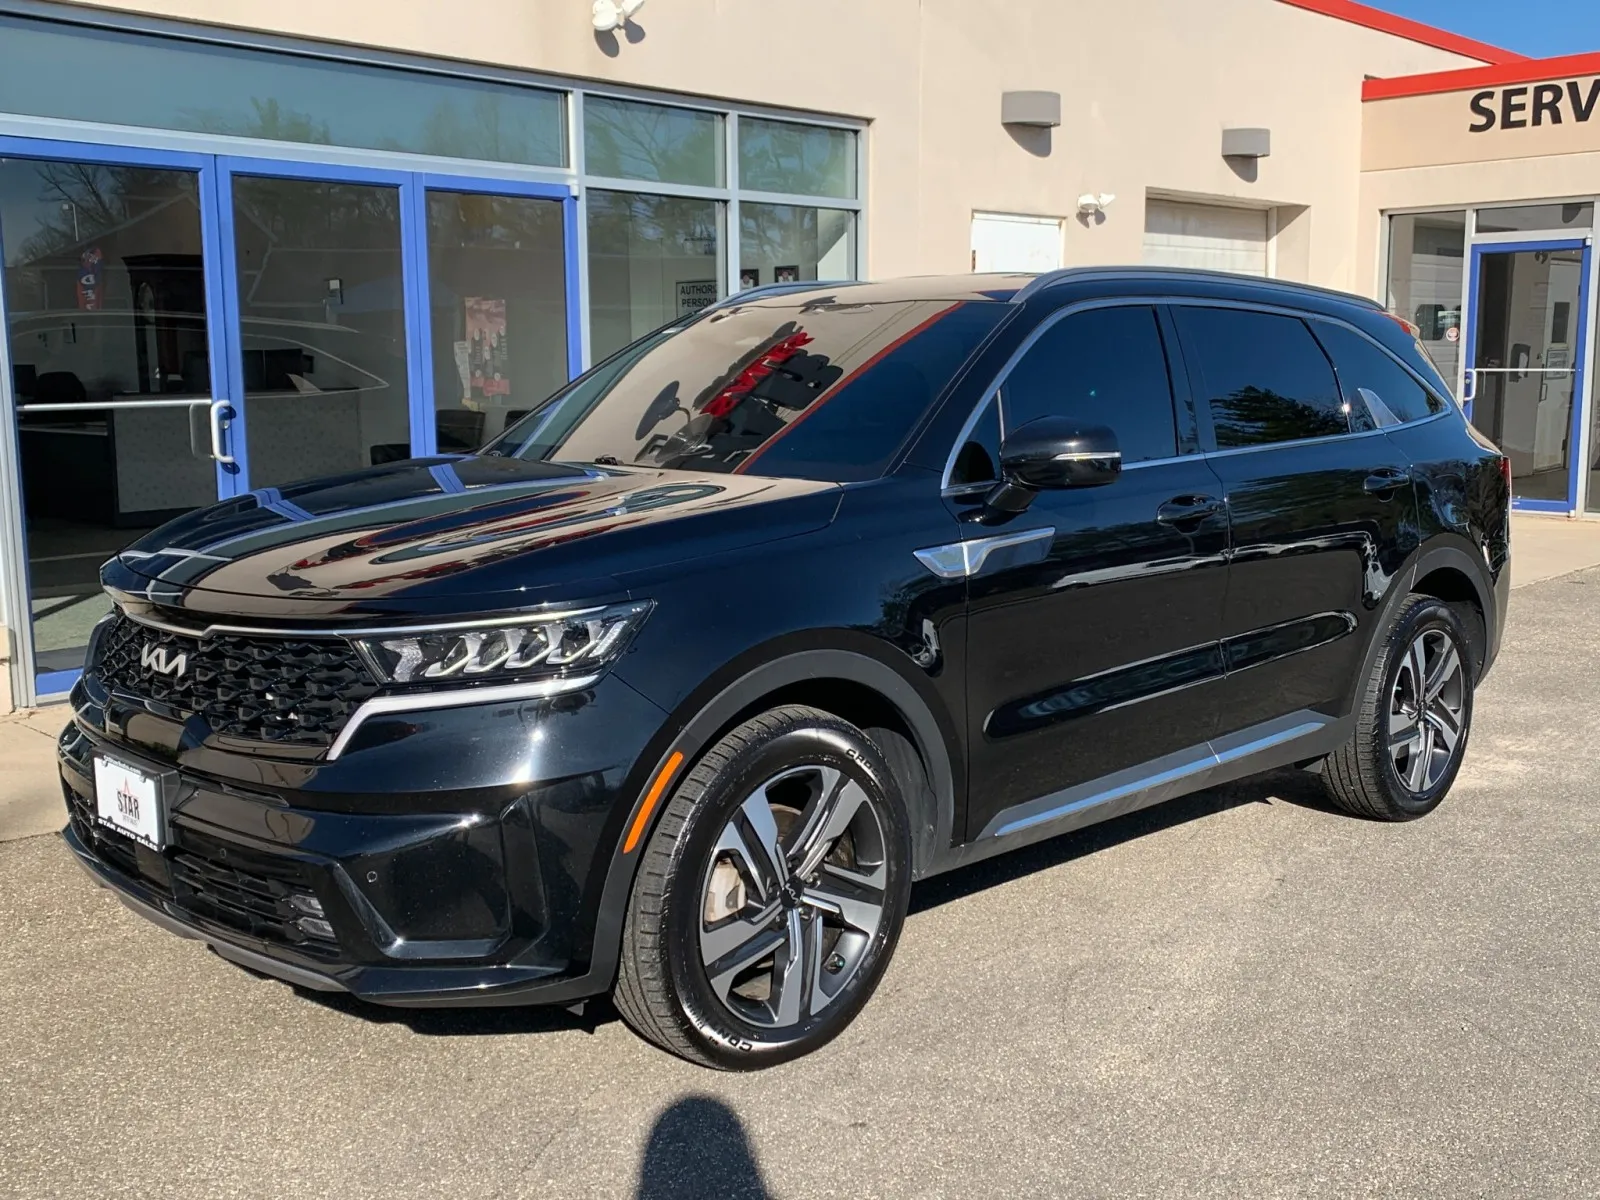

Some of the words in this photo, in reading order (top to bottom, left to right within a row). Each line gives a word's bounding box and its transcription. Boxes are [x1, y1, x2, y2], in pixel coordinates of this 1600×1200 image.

[1469, 79, 1600, 133] SERV
[117, 790, 140, 820] STAR
[98, 818, 116, 831] STAR
[116, 827, 136, 840] AUTO
[136, 836, 158, 852] SALES
